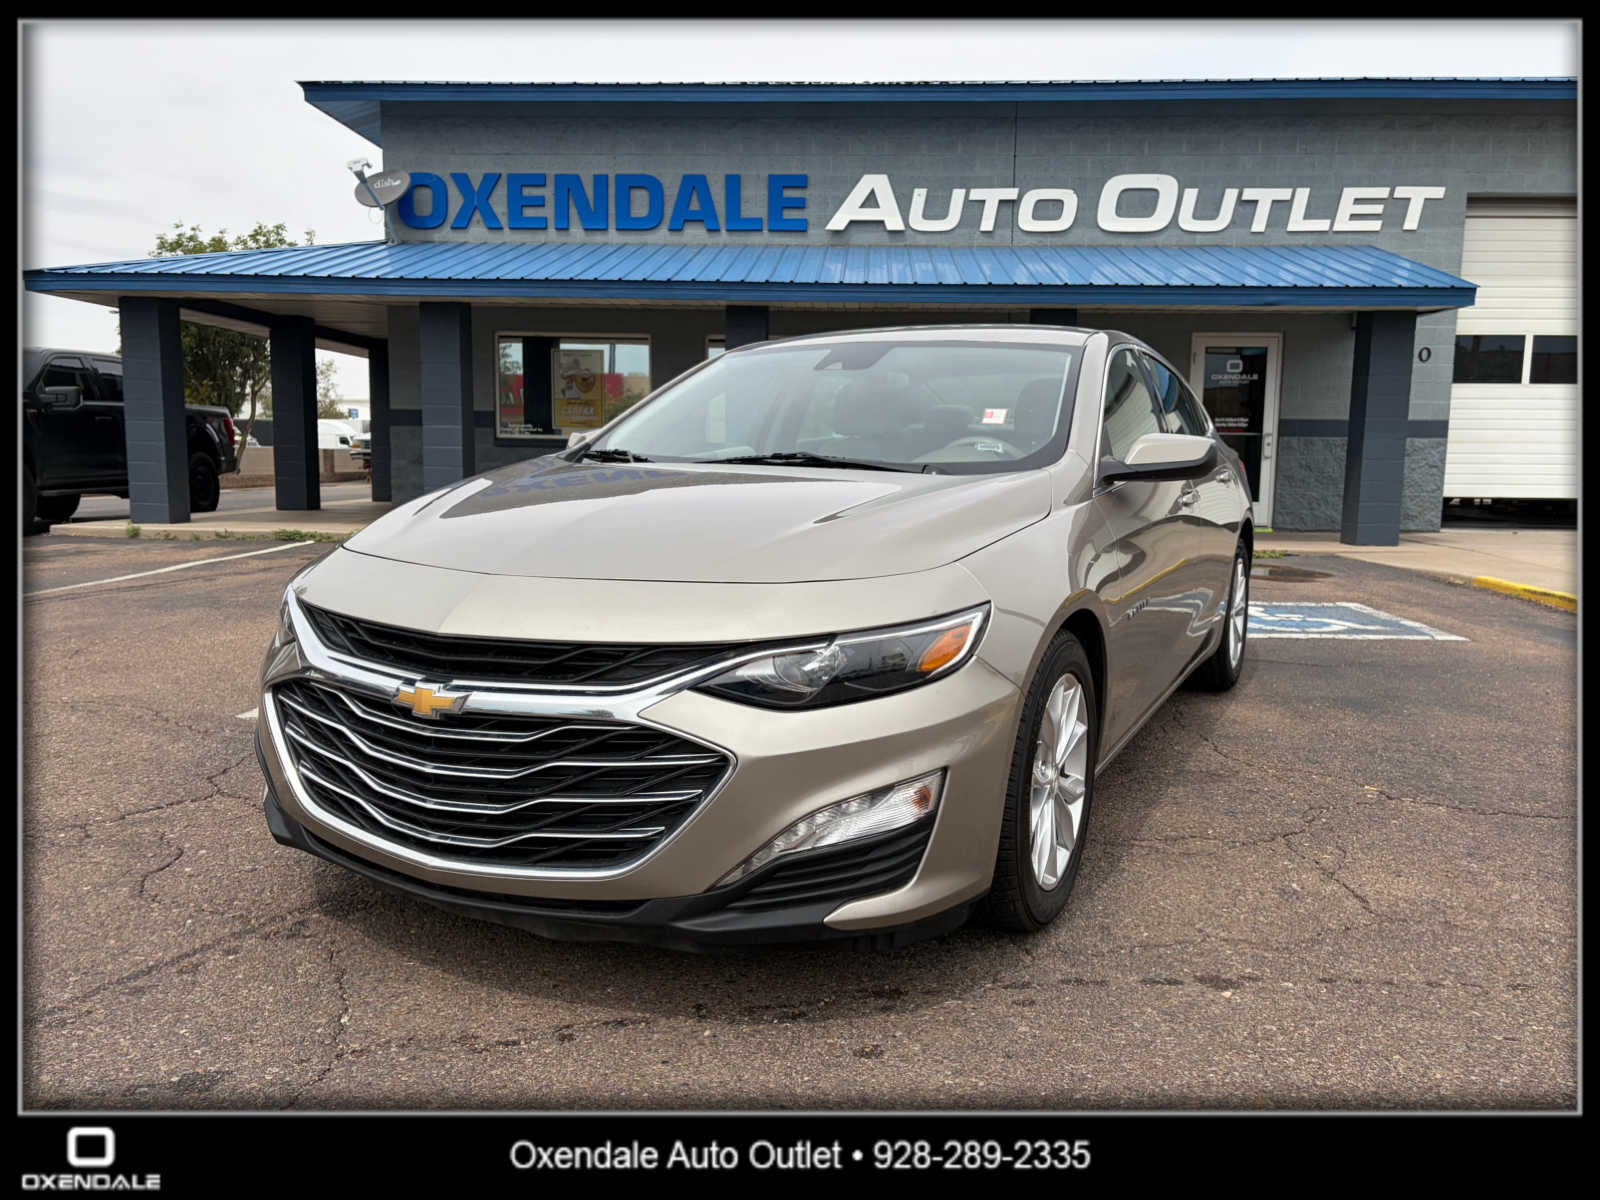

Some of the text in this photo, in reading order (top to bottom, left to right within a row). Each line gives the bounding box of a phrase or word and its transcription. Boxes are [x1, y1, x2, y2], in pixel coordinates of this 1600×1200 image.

[399, 172, 1445, 232] OXENDALE AUTO OUTLET
